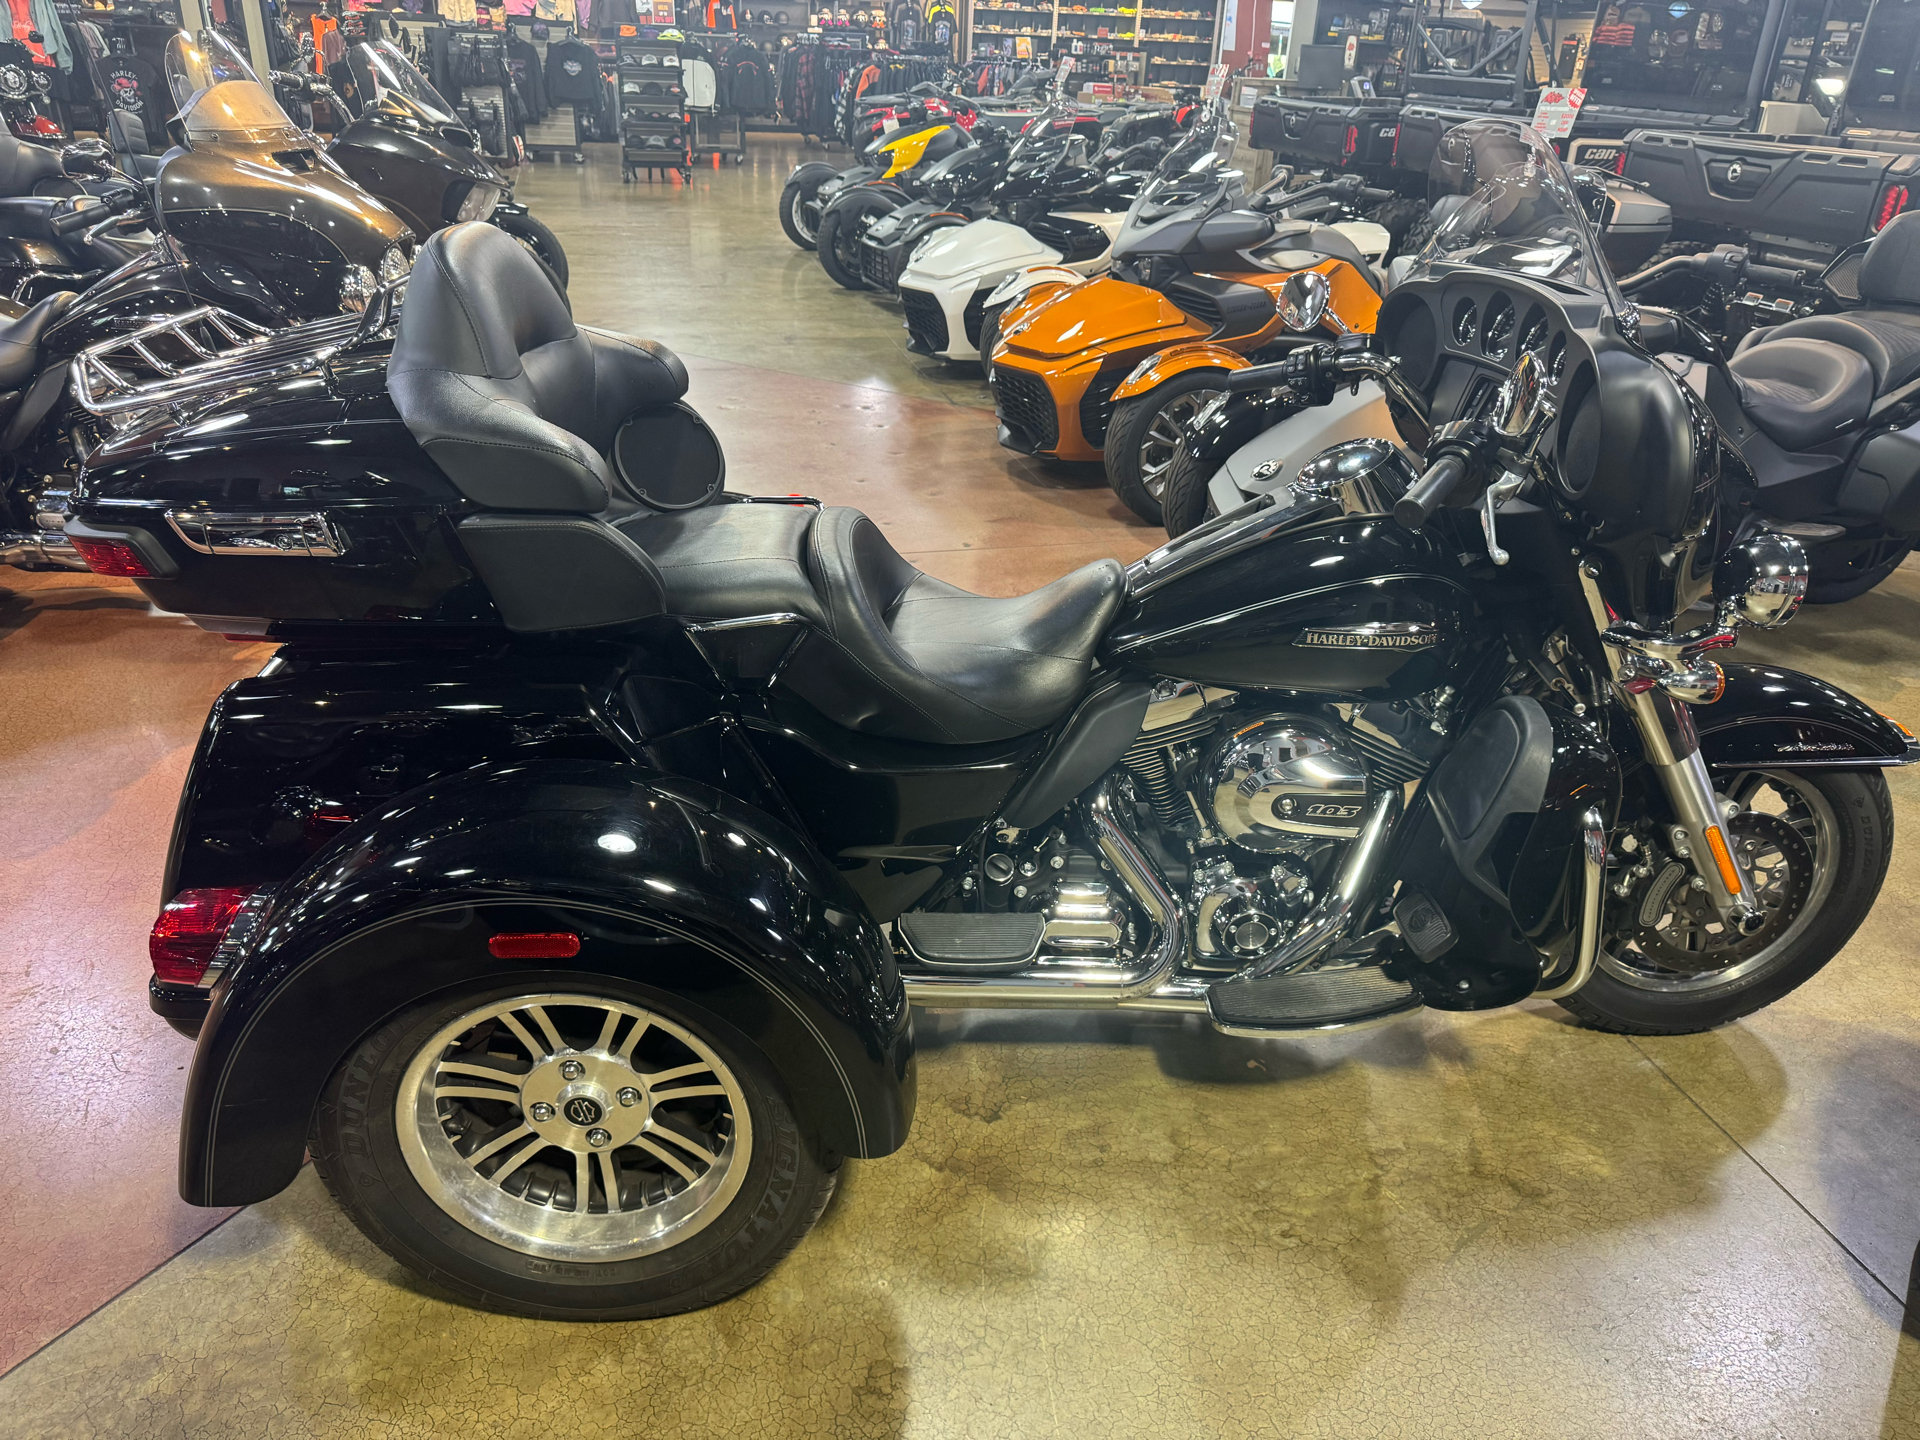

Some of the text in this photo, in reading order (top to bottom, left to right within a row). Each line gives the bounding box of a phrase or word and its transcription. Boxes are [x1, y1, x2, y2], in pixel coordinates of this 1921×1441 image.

[110, 70, 138, 80] HARLEY-
[115, 99, 144, 111] DAVIDSON
[1305, 632, 1438, 647] HARLEY-DAVIDSON
[1305, 803, 1362, 818] 103
[341, 1012, 417, 1159] DUNLOP
